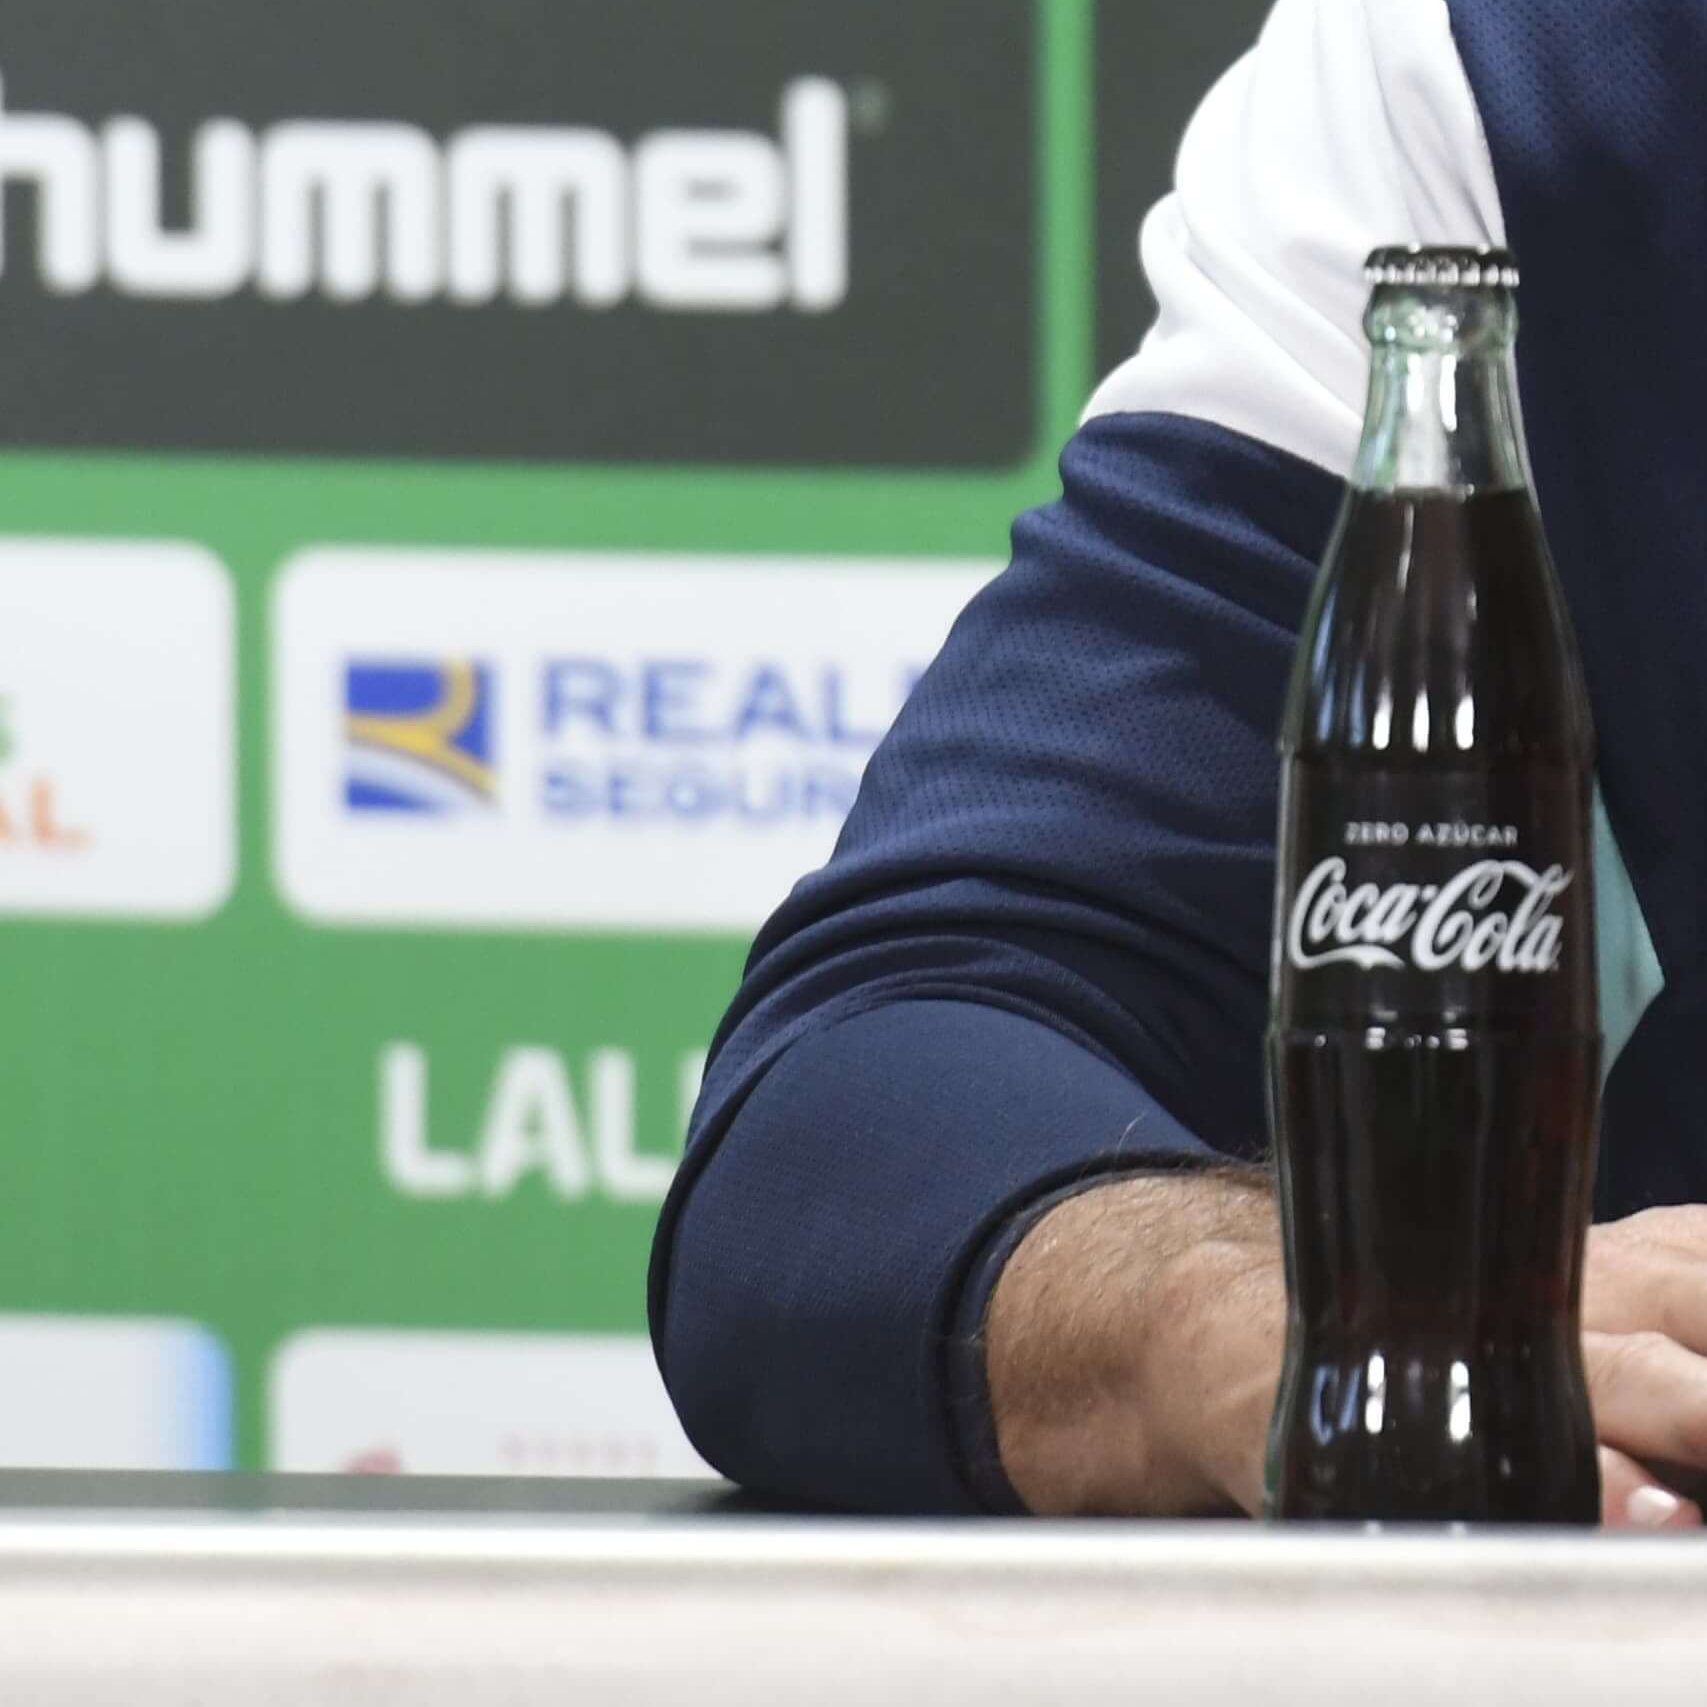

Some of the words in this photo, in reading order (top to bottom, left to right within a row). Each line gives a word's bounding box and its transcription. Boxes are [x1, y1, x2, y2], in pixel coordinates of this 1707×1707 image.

[538, 657, 922, 744] REAL
[1345, 821, 1409, 845] ZERO
[1288, 856, 1574, 971] Coca-Cola
